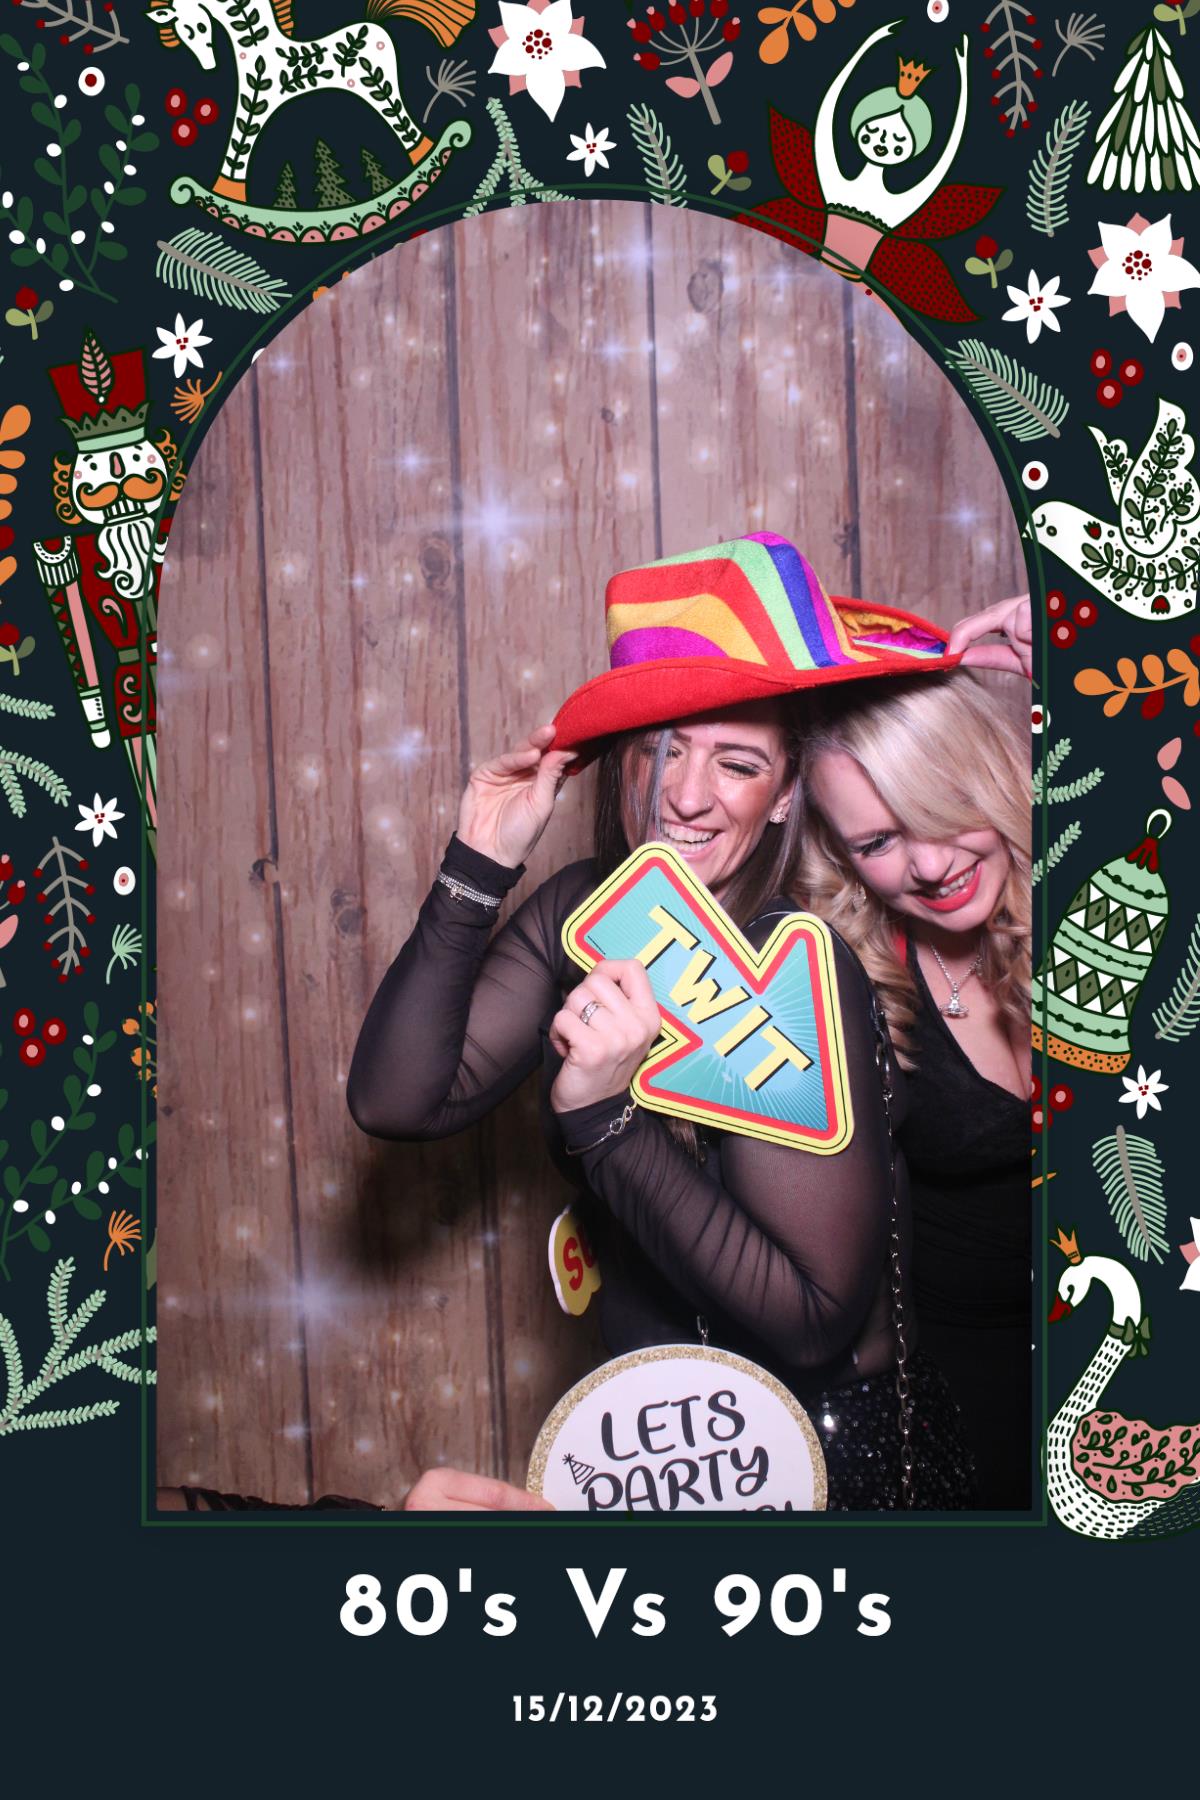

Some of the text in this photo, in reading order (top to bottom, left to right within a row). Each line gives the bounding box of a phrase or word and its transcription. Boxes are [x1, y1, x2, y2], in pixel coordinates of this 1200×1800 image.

[634, 904, 814, 1092] TWIT
[601, 1390, 746, 1462] LETS
[581, 1445, 770, 1511] PARTY
